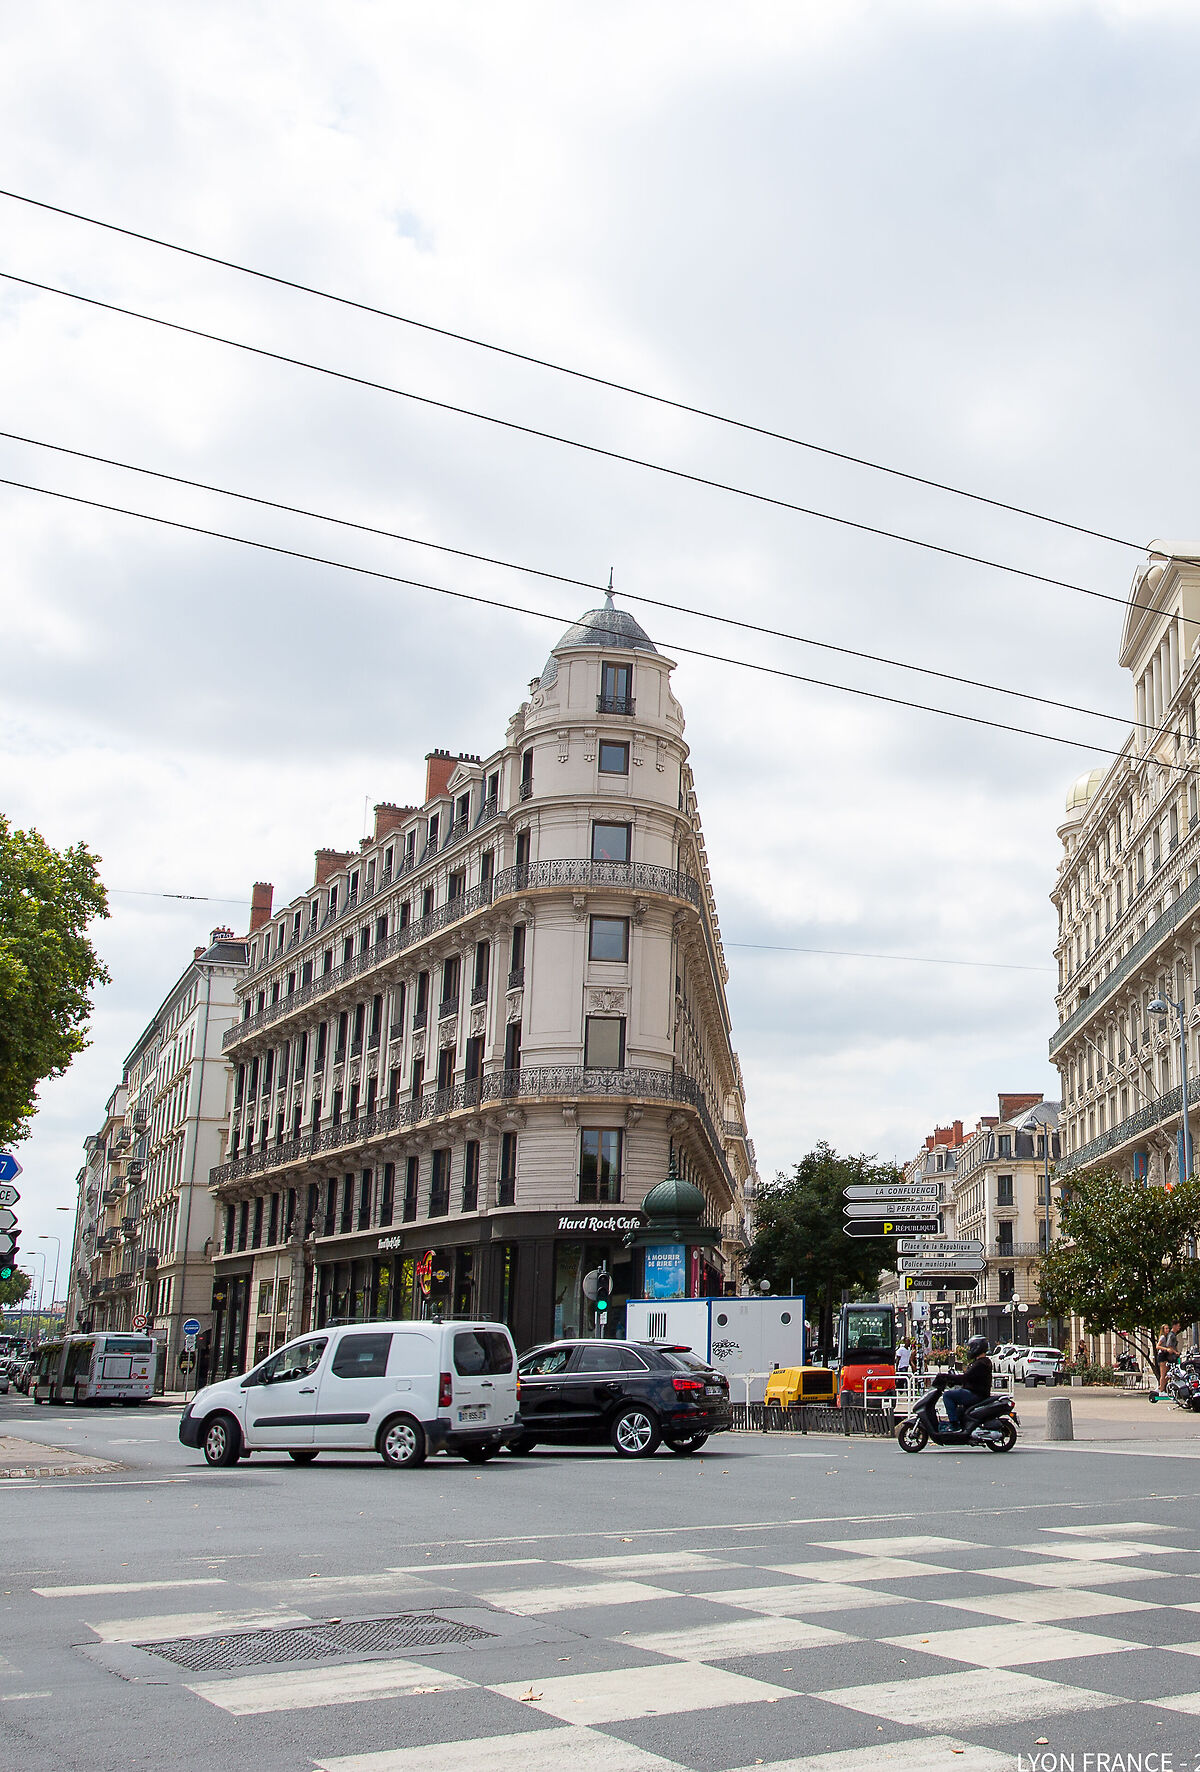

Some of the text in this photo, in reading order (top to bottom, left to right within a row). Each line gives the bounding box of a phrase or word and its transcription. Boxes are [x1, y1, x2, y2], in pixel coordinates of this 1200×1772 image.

[888, 1187, 935, 1195] CONFLUENCE
[896, 1204, 935, 1212] PERRACHE
[558, 1217, 640, 1231] Hard Rock Cafe
[895, 1224, 936, 1232] RÉPUBLIQUE
[940, 1243, 970, 1251] République
